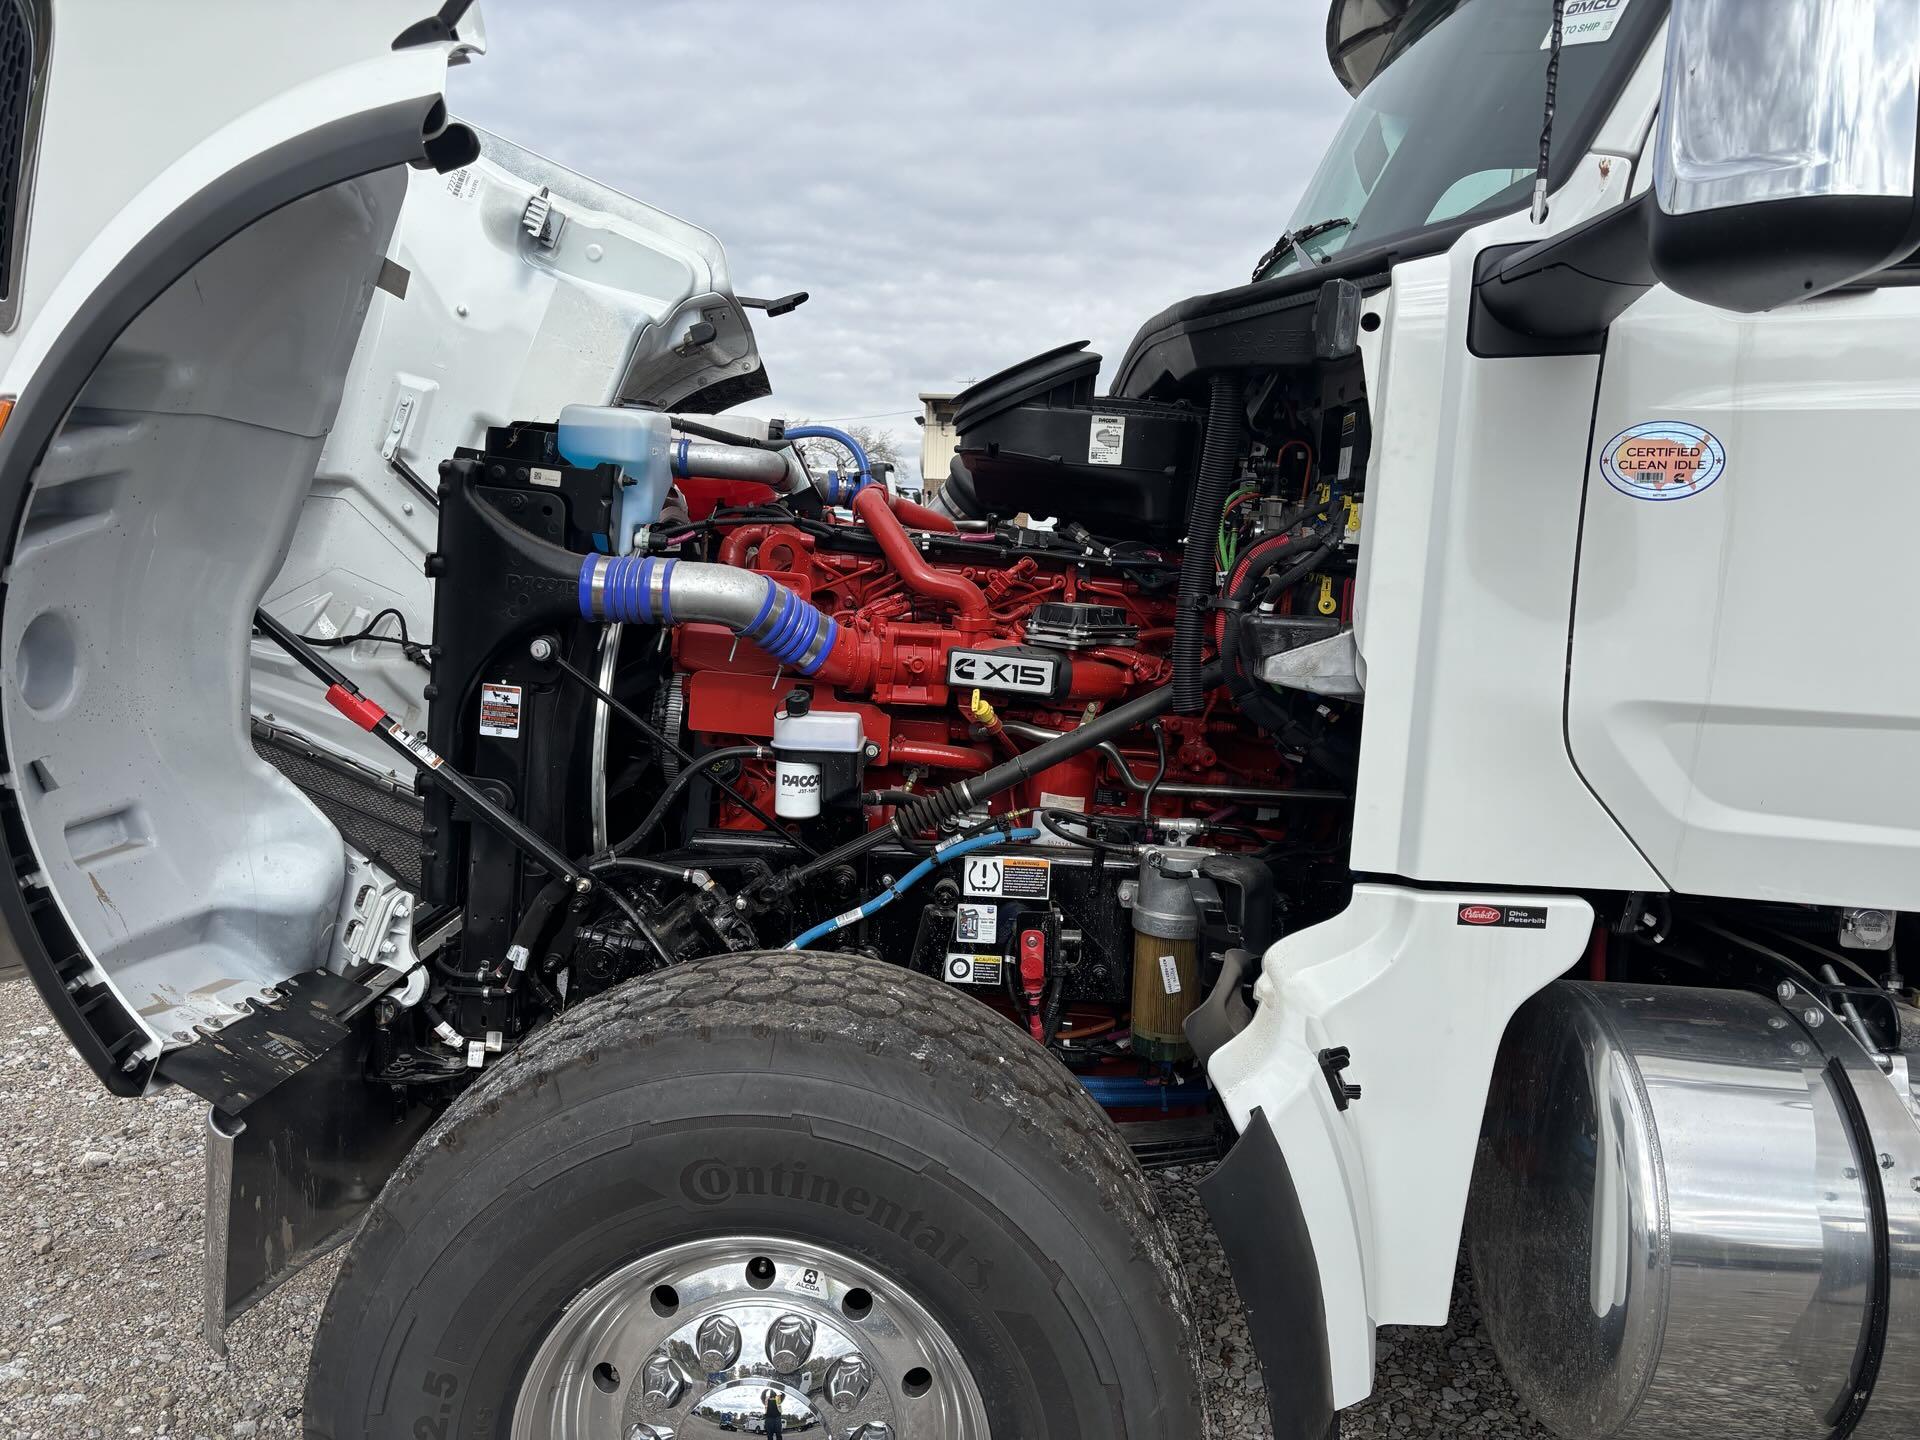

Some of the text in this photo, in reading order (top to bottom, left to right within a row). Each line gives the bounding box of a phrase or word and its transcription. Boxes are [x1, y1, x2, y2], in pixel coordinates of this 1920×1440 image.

[1564, 22, 1601, 35] TO SHIP
[1626, 447, 1700, 457] CERTIFIED
[1618, 460, 1706, 470] CLEAN IDLE
[982, 661, 1045, 686] X15
[1464, 908, 1498, 921] Peterbilt
[680, 1157, 968, 1266] Continental
[796, 1281, 821, 1292] ALCOA
